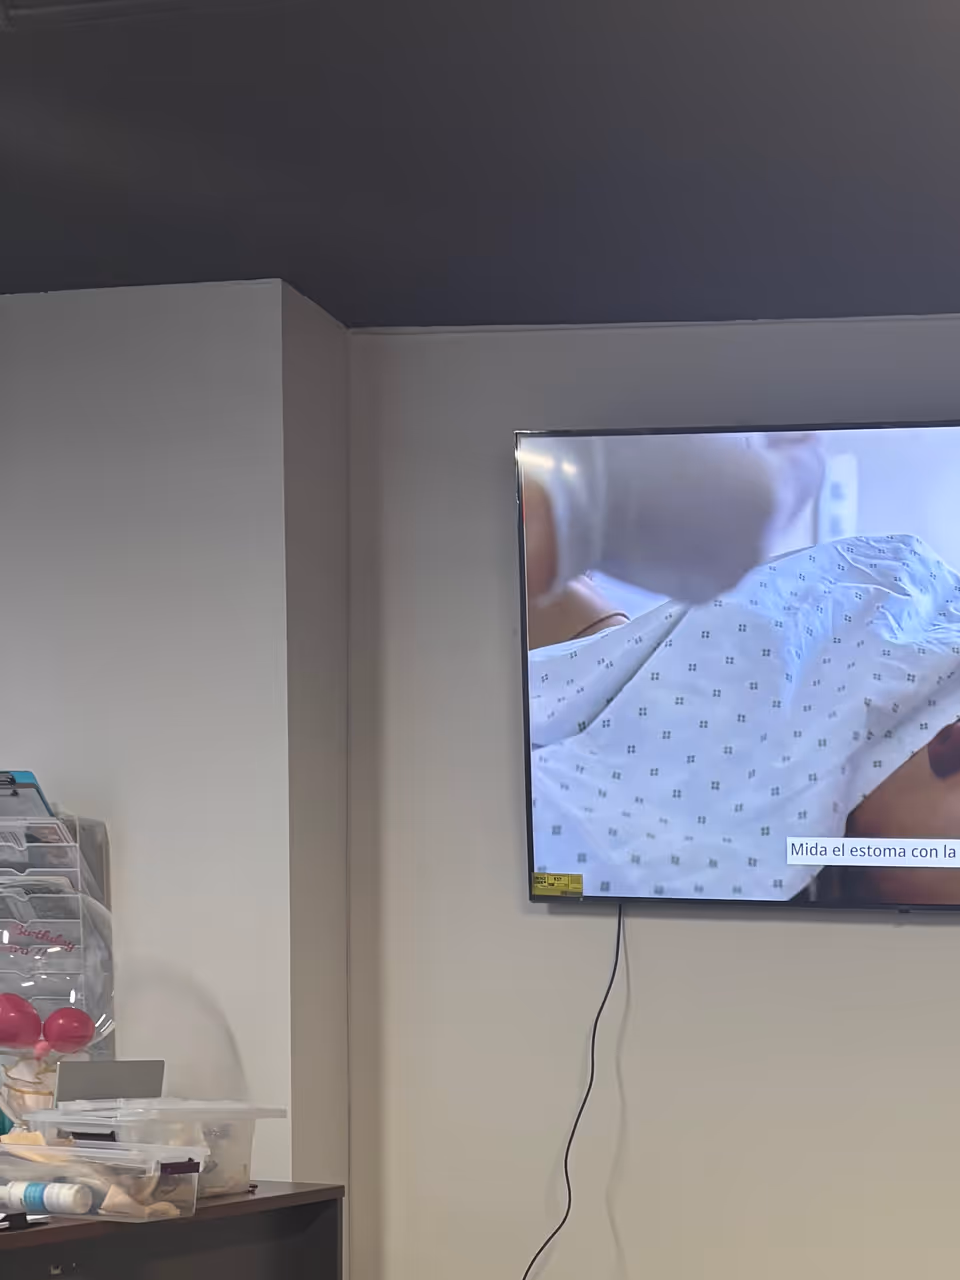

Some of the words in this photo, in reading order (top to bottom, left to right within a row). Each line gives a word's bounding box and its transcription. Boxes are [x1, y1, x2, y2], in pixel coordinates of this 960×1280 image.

[791, 842, 827, 857] Mida
[832, 843, 845, 857] el
[850, 845, 906, 858] estoma
[911, 847, 938, 858] con
[944, 844, 956, 859] la
